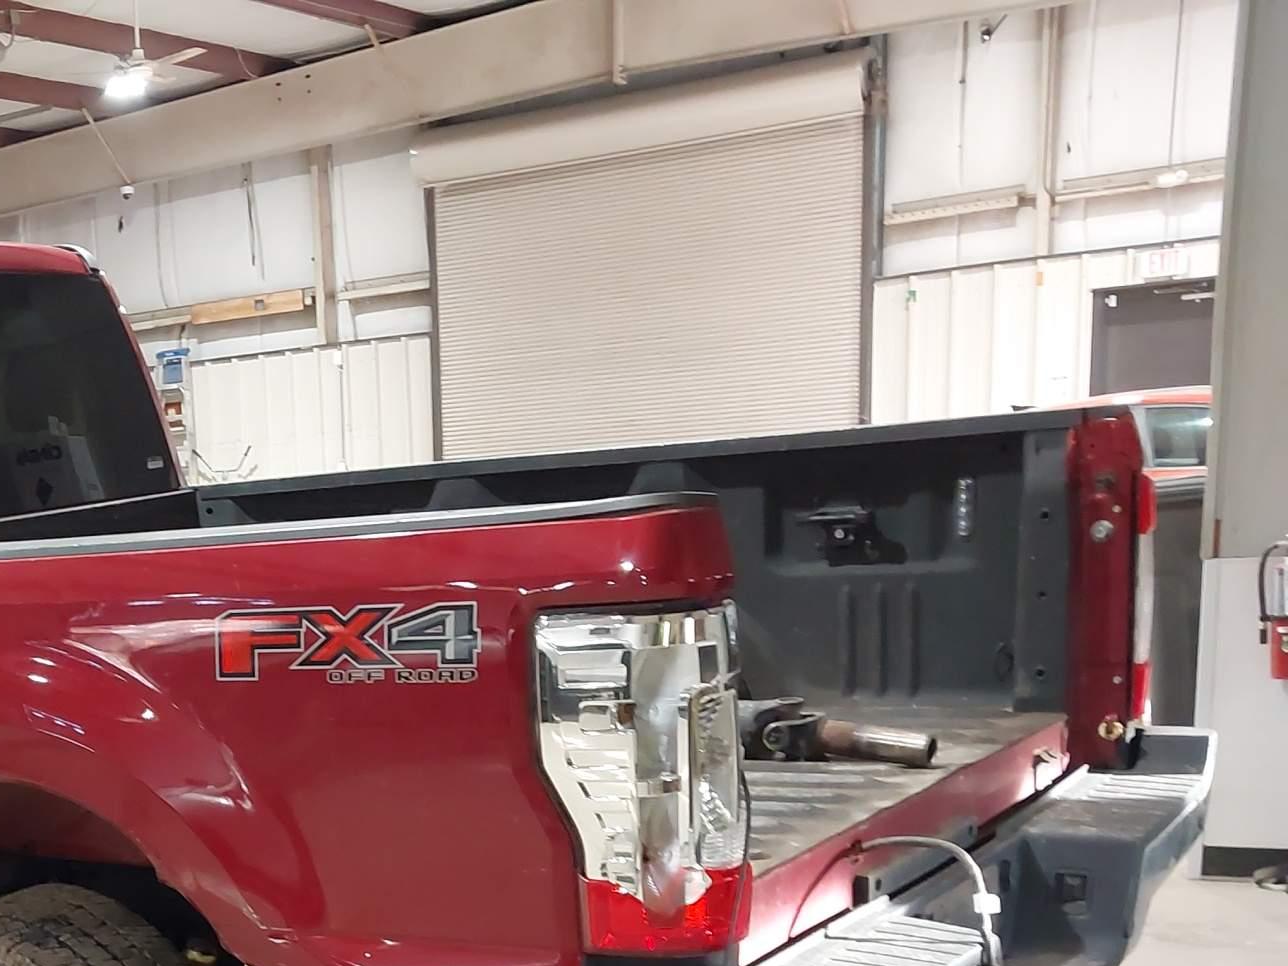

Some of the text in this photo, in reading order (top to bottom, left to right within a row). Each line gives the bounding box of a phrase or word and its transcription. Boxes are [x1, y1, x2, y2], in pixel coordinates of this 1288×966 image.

[215, 601, 481, 680] FX4
[327, 669, 478, 684] OFF ROAD
